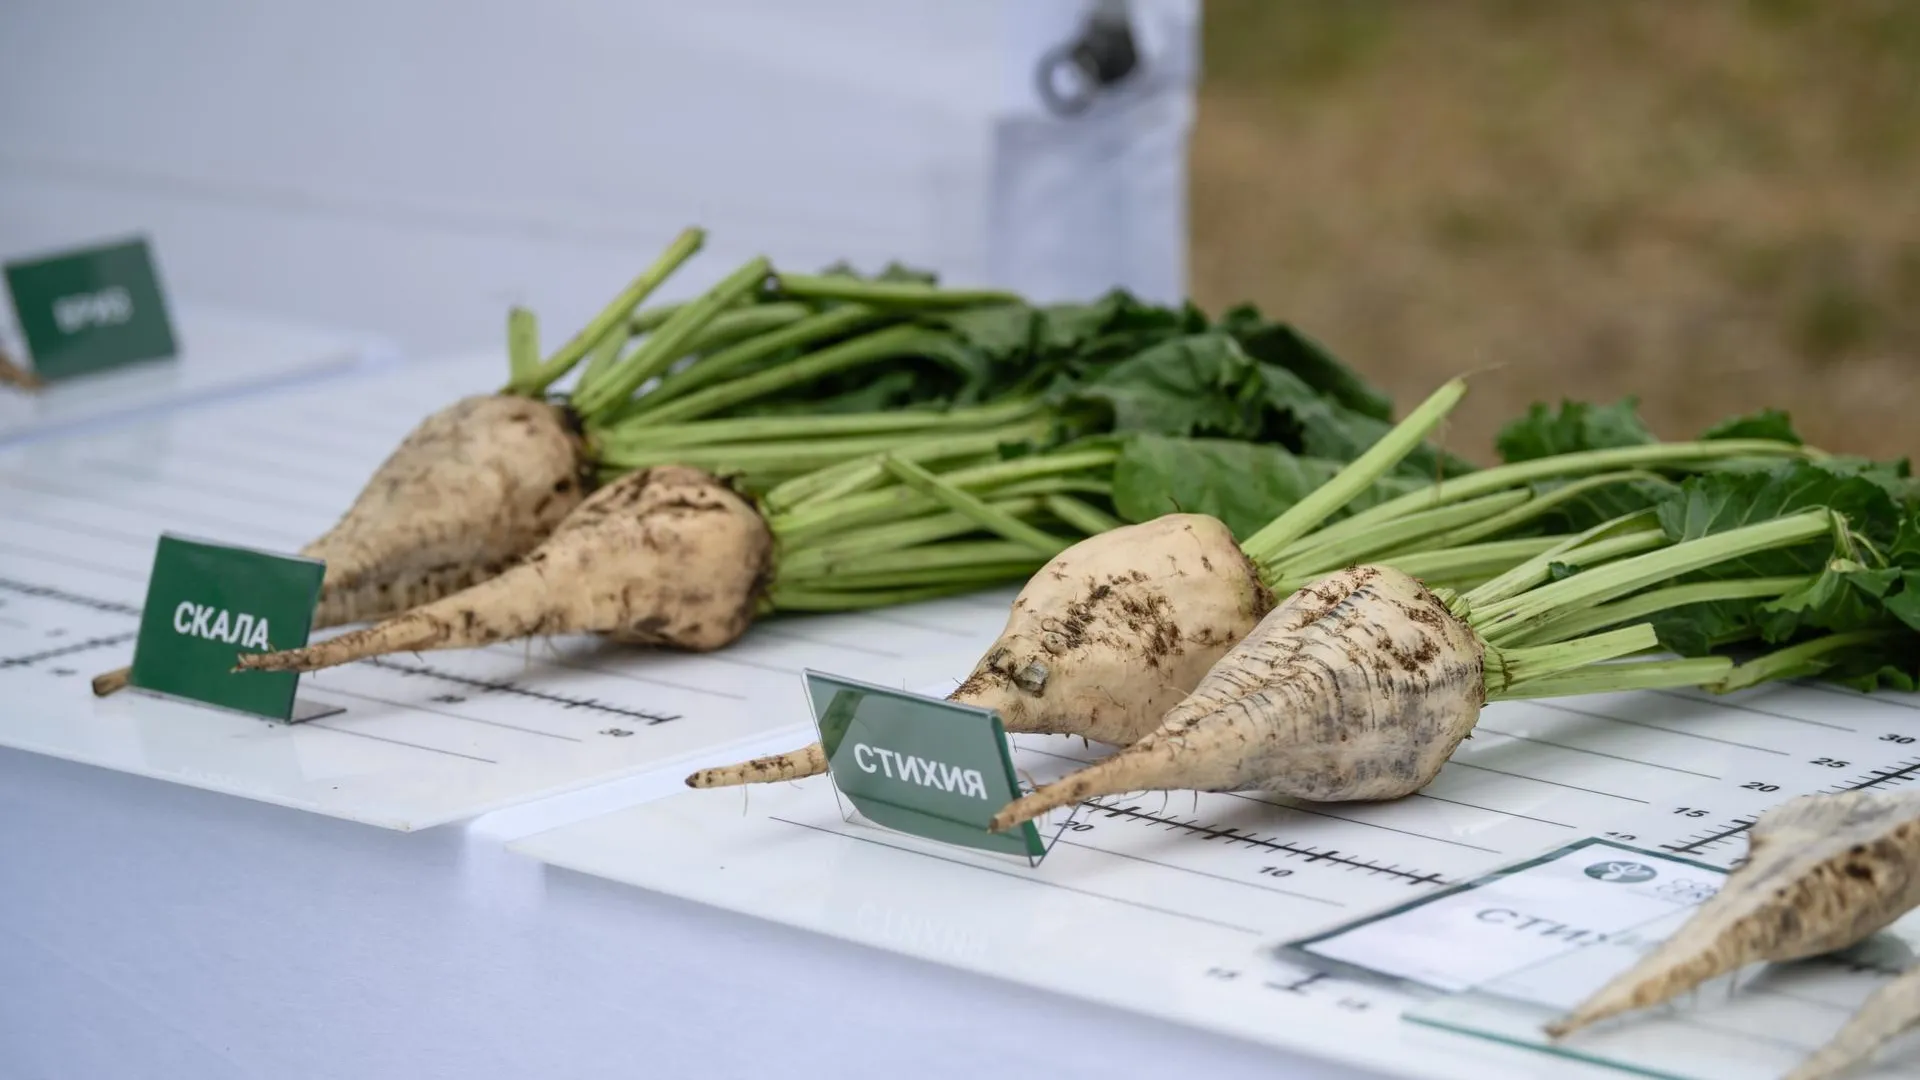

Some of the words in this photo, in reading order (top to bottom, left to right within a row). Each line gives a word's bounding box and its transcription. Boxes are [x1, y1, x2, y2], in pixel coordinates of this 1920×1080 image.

[174, 600, 268, 651] СКАЛА
[1878, 733, 1916, 745] 30
[1809, 757, 1850, 769] 25
[853, 742, 988, 801] СТИХИЯ
[1739, 781, 1780, 793] 20
[1672, 806, 1710, 818] 15
[1258, 866, 1294, 878] 10
